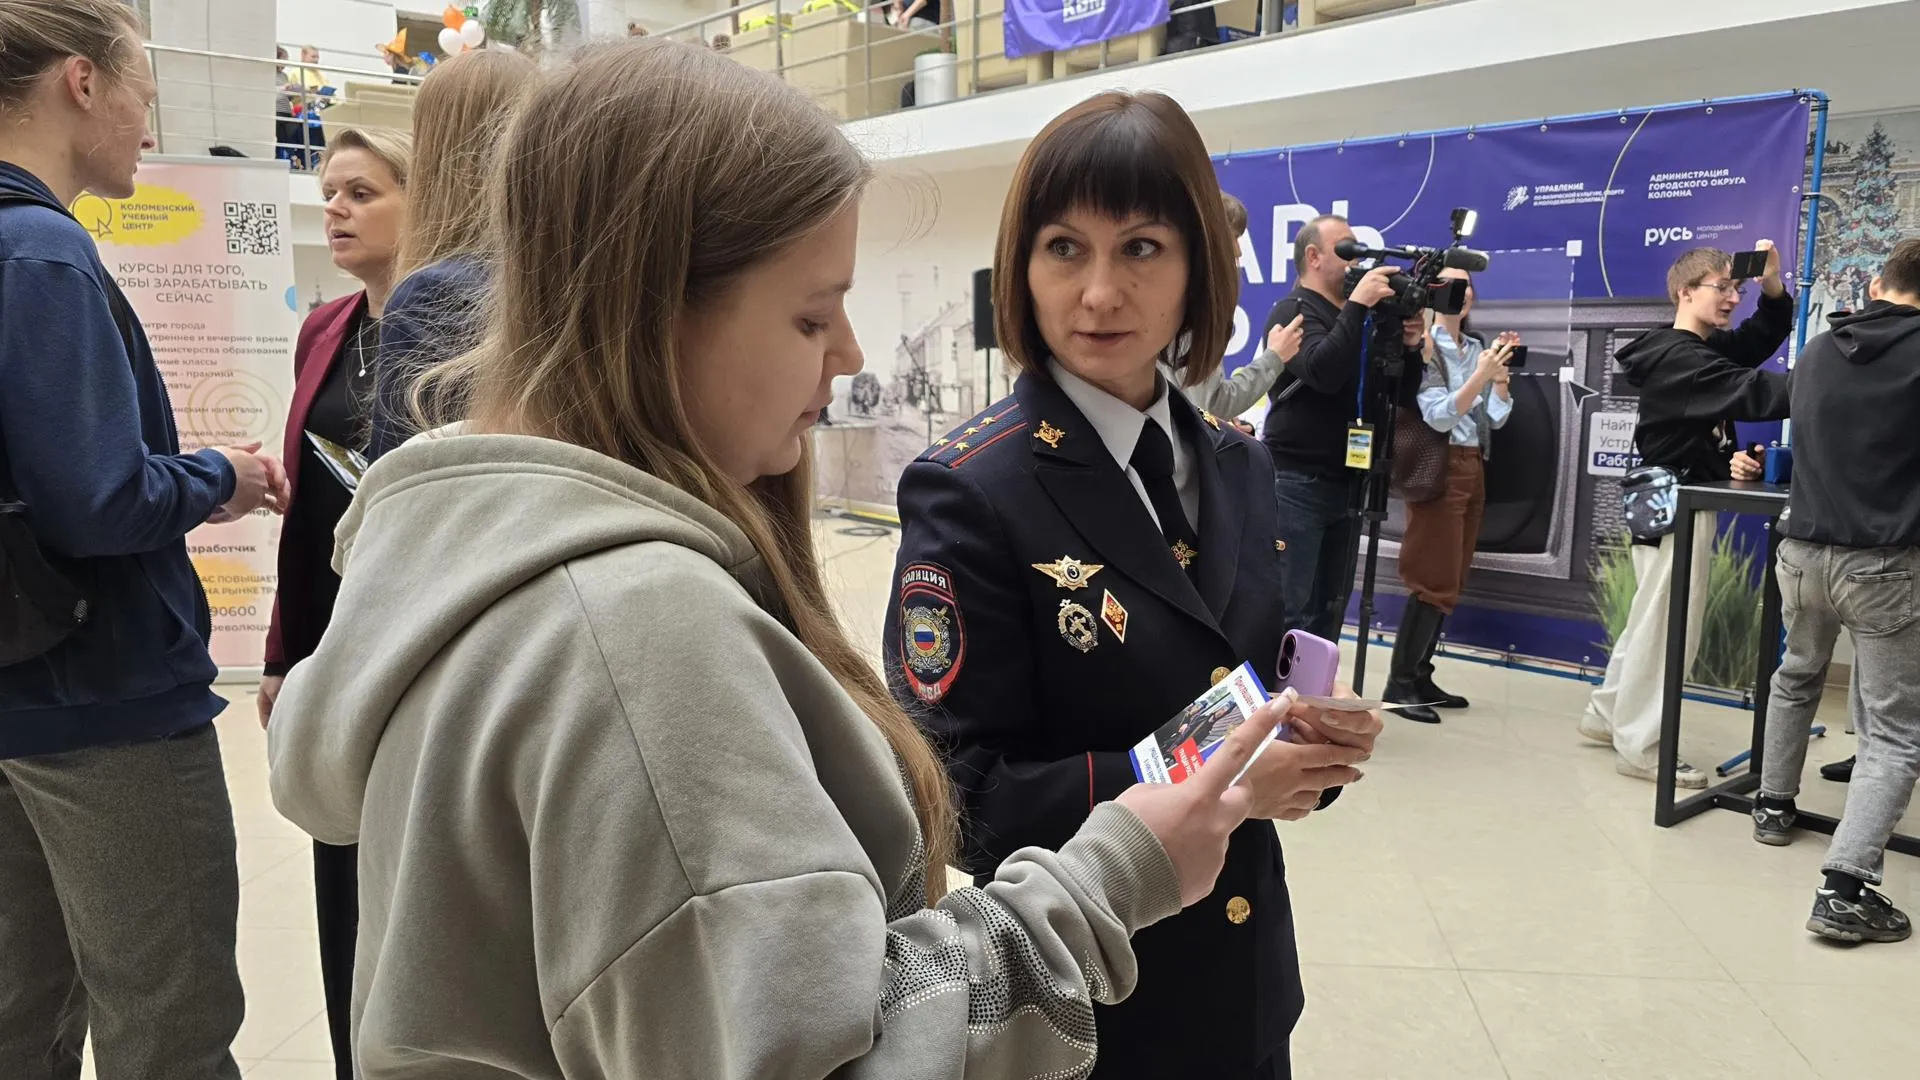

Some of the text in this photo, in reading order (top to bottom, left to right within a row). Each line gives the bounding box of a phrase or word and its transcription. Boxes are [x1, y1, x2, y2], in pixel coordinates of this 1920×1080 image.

[1649, 168, 1730, 182] АДМИНИСТРАЦИЯ
[1535, 182, 1584, 193] УПРАВЛЕНИЕ
[1648, 176, 1747, 191] ГОРОДСКОГО ОКРУГА
[1647, 189, 1693, 199] КОЛОМНА
[120, 203, 195, 212] КОЛОМЕНСКИЙ
[122, 213, 169, 221] УЧЕБНЫЙ
[123, 223, 154, 231] ЦЕНТР
[1644, 226, 1693, 247] русь
[1696, 232, 1719, 240] центр
[118, 263, 245, 277] КУРСЫ ДЛЯ ТОГО,
[116, 277, 268, 290] ОБЫ ЗАРАБАТЫВАТЬ
[156, 290, 214, 303] СЕЙЧАС
[901, 569, 947, 589] ПОЛИЦИЯ
[222, 587, 259, 595] РЫНКЕ
